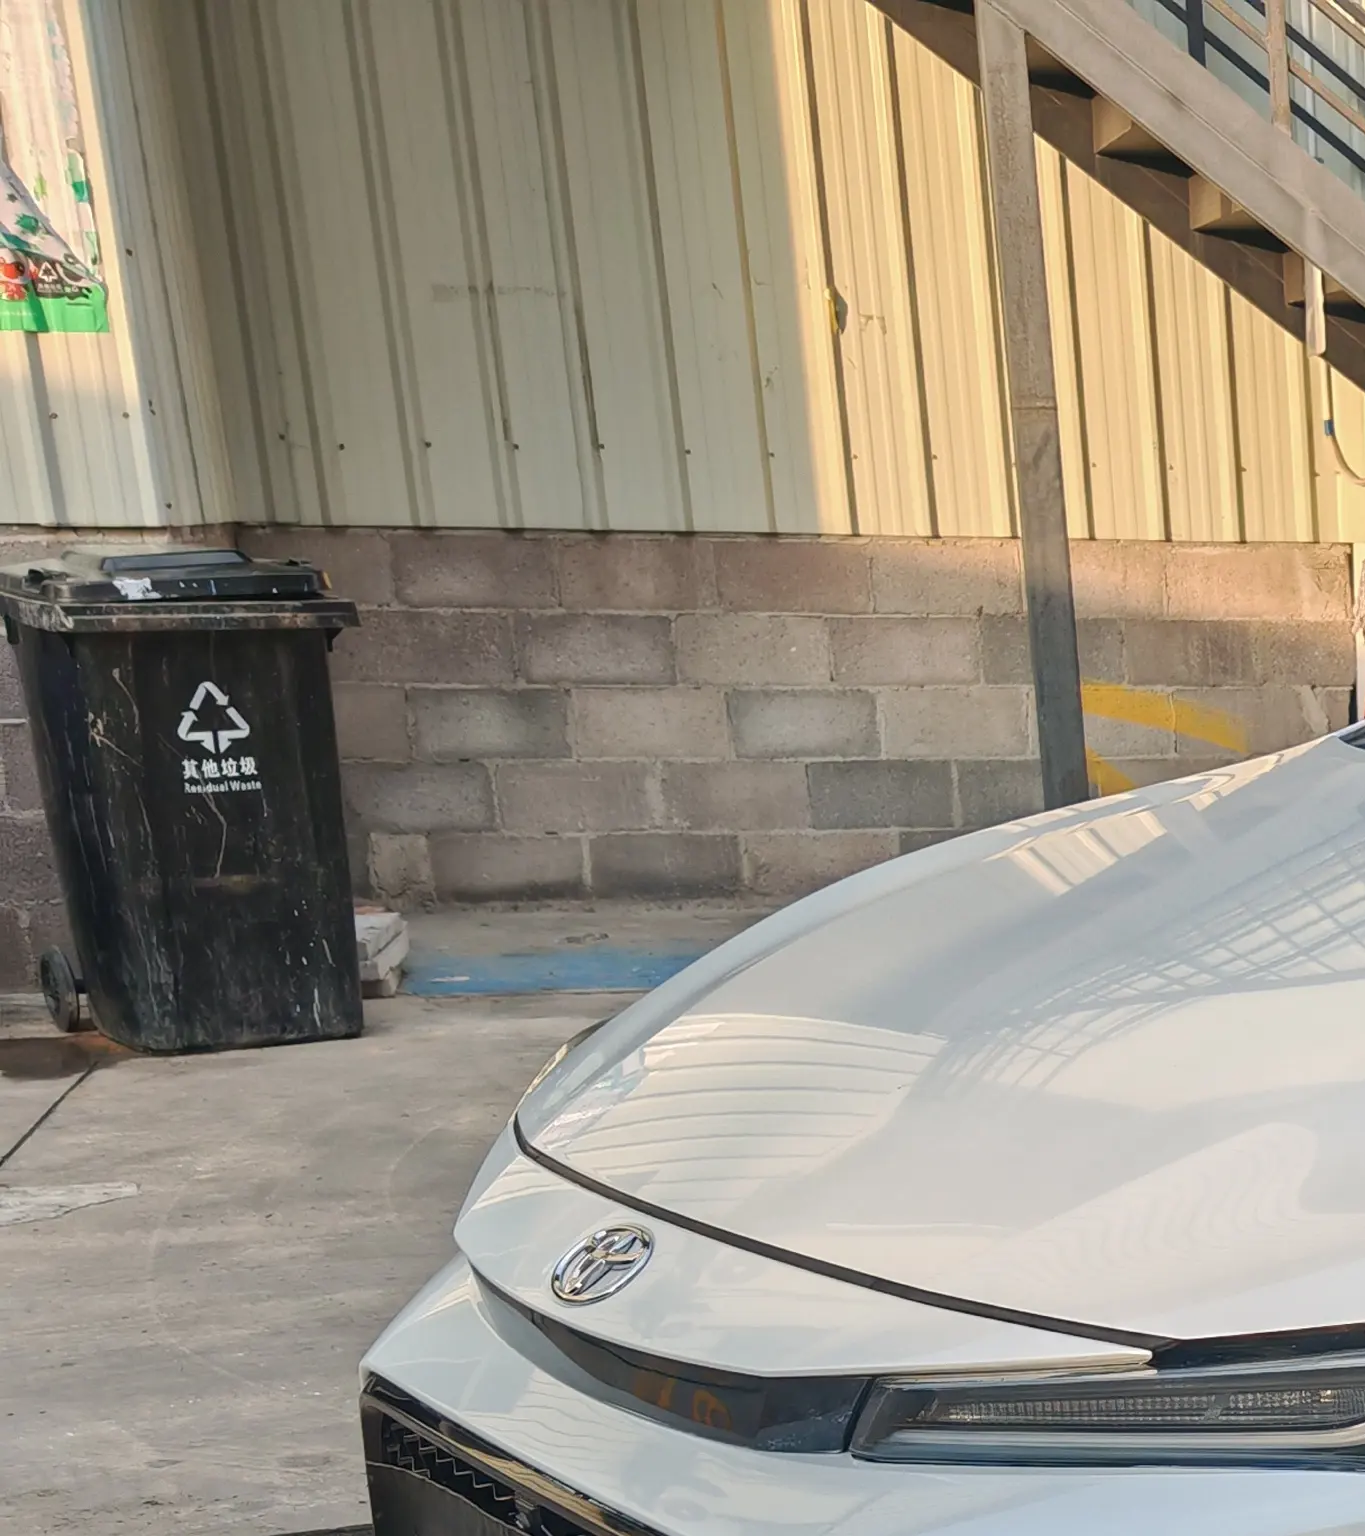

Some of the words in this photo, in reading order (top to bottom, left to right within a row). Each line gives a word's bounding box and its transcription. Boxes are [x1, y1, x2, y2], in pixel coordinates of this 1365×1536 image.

[181, 756, 258, 779] 其他垃圾
[183, 780, 229, 794] Residual
[229, 780, 262, 792] Waste
